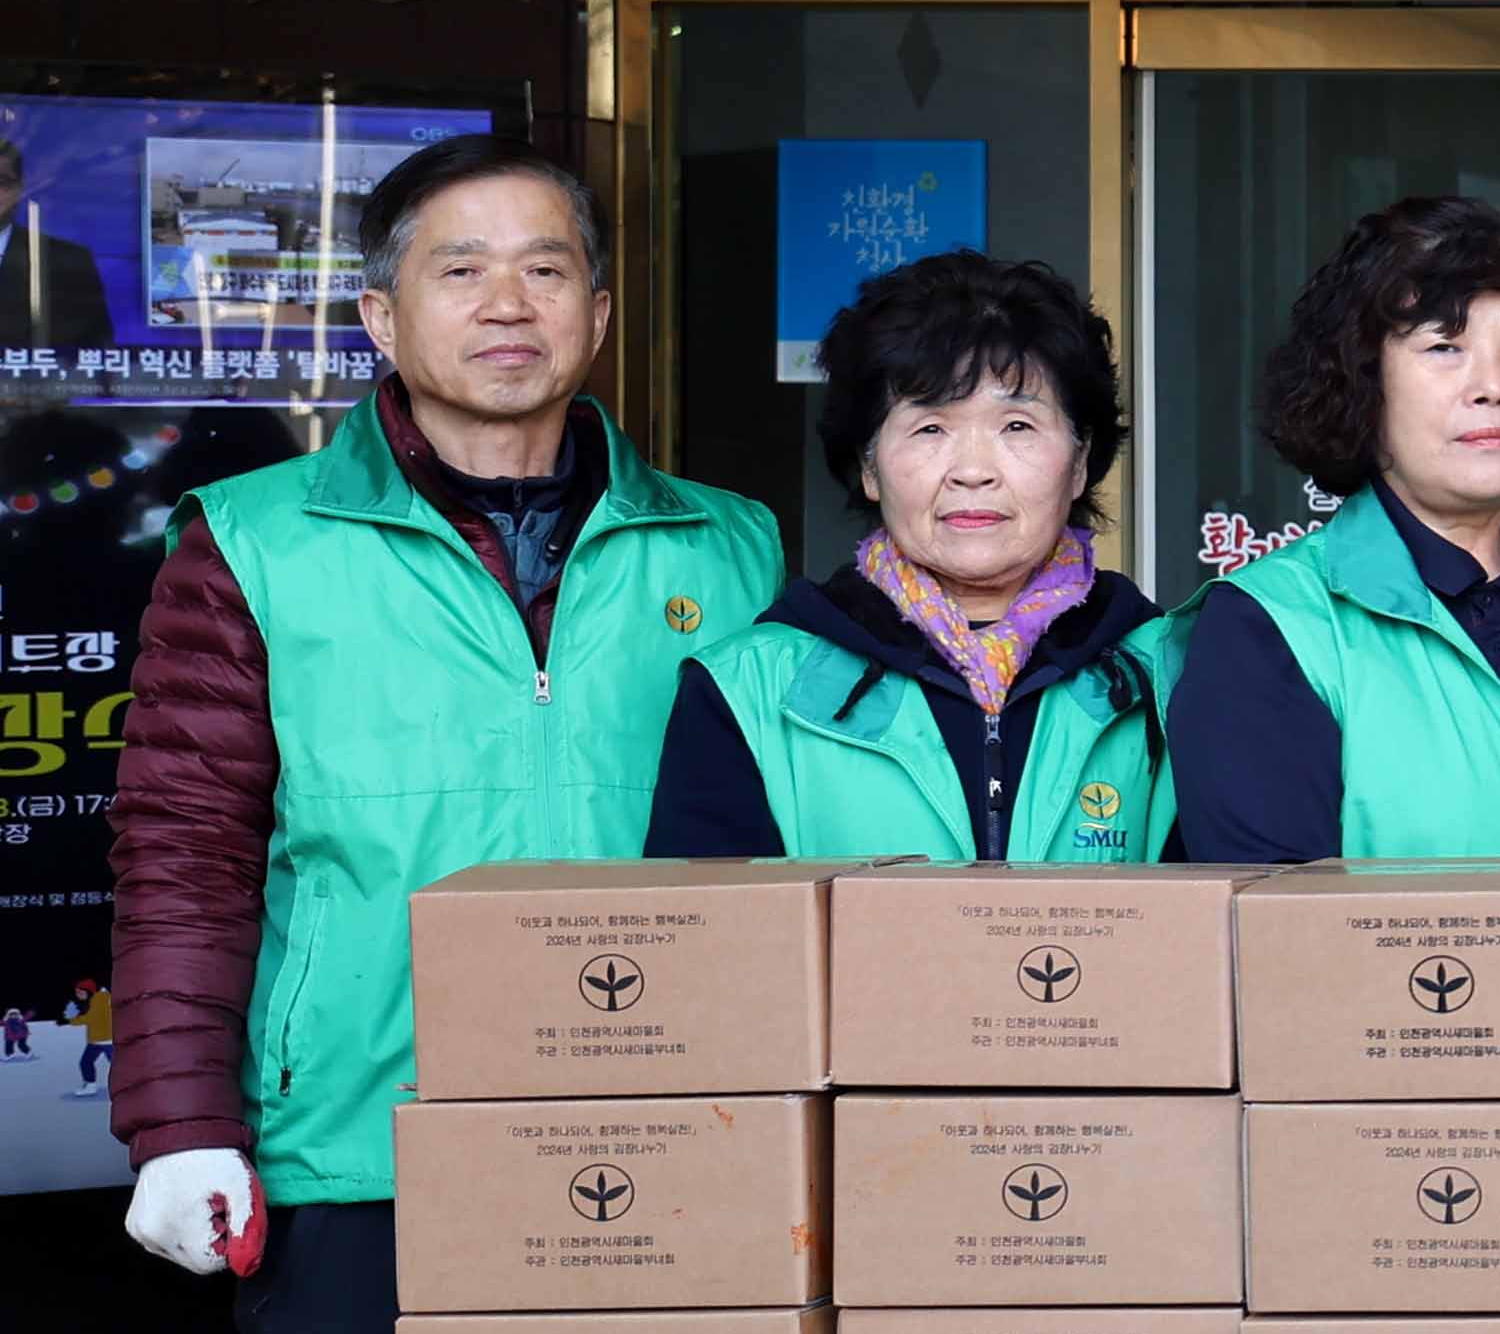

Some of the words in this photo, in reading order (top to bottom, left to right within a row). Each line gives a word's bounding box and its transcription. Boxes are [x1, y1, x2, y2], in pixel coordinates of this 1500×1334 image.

[0, 348, 67, 380] 부두,
[76, 347, 130, 379] 뿌리
[139, 348, 192, 380] 혁신
[0, 631, 120, 673] 트깡
[1072, 828, 1128, 849] SMU
[544, 934, 582, 947] 2024년
